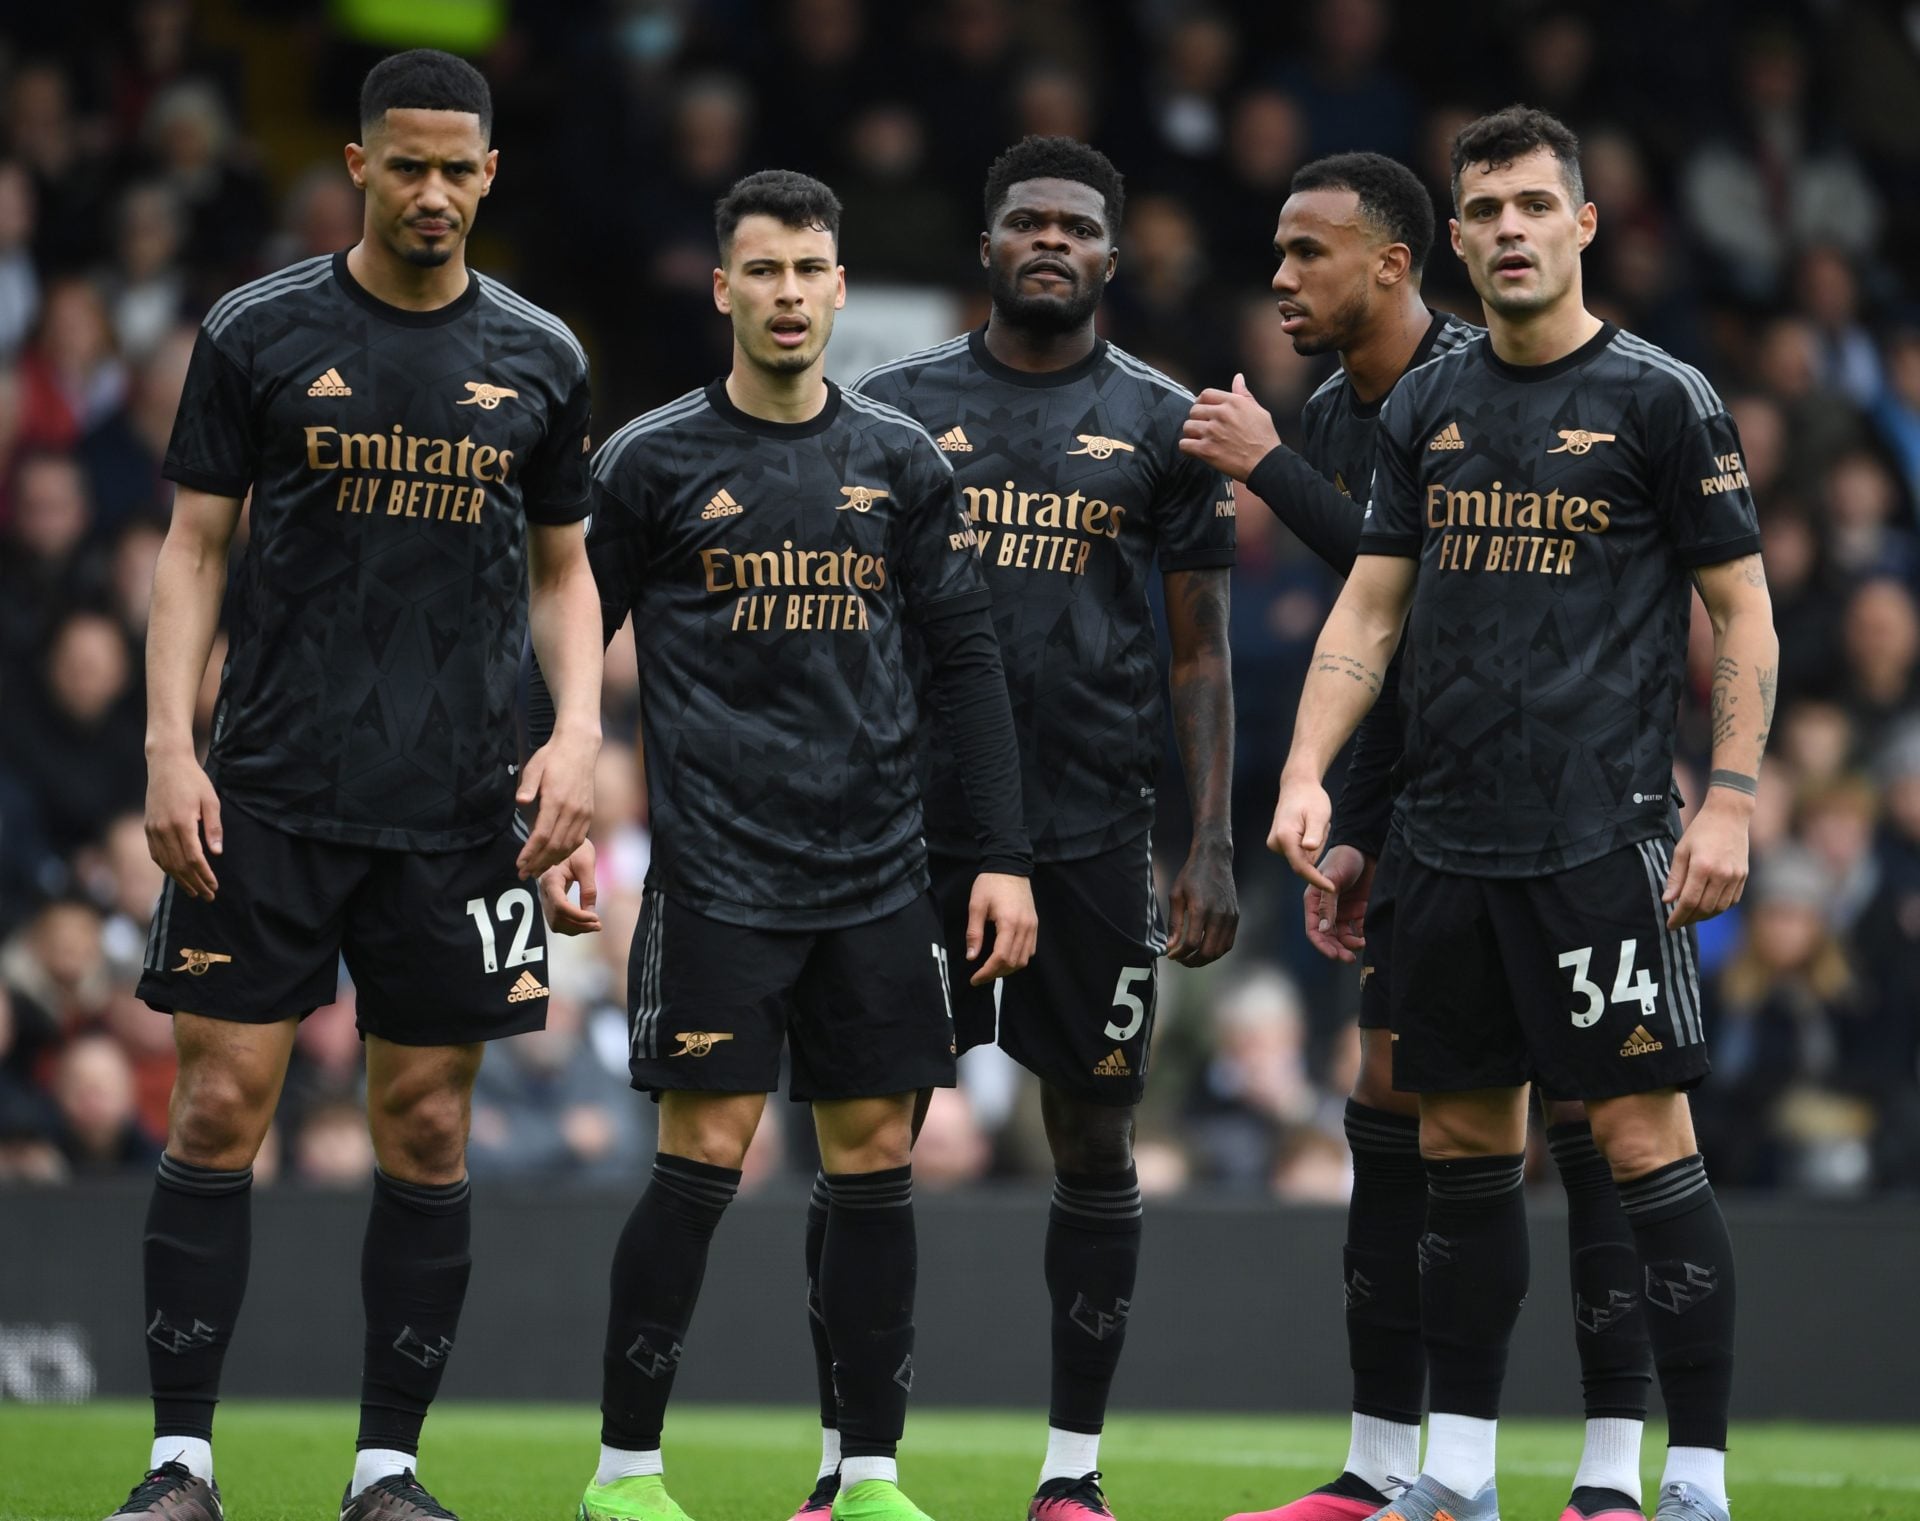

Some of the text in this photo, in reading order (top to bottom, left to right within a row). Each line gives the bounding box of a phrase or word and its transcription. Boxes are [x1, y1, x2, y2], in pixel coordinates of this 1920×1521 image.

[308, 385, 352, 397] adidas
[304, 424, 514, 484] Emirates
[938, 440, 973, 452] didas
[1430, 440, 1465, 450] adidas
[336, 477, 485, 524] FLY BETTER
[1701, 471, 1750, 496] RWAN
[701, 504, 744, 520] adidas
[962, 480, 1126, 539] mirates
[1215, 500, 1236, 517] RWA
[1427, 481, 1611, 534] Emirates
[700, 540, 886, 592] Emirates
[997, 532, 1091, 576] BETTER
[1438, 534, 1576, 575] FLY BETTER
[731, 594, 869, 631] FLY BETTER
[466, 888, 544, 973] 12
[507, 986, 550, 1003] adidas
[1558, 938, 1659, 1028] 34
[1104, 966, 1152, 1041] 5
[1620, 1041, 1663, 1057] adidas
[1093, 1065, 1132, 1077] adidas
